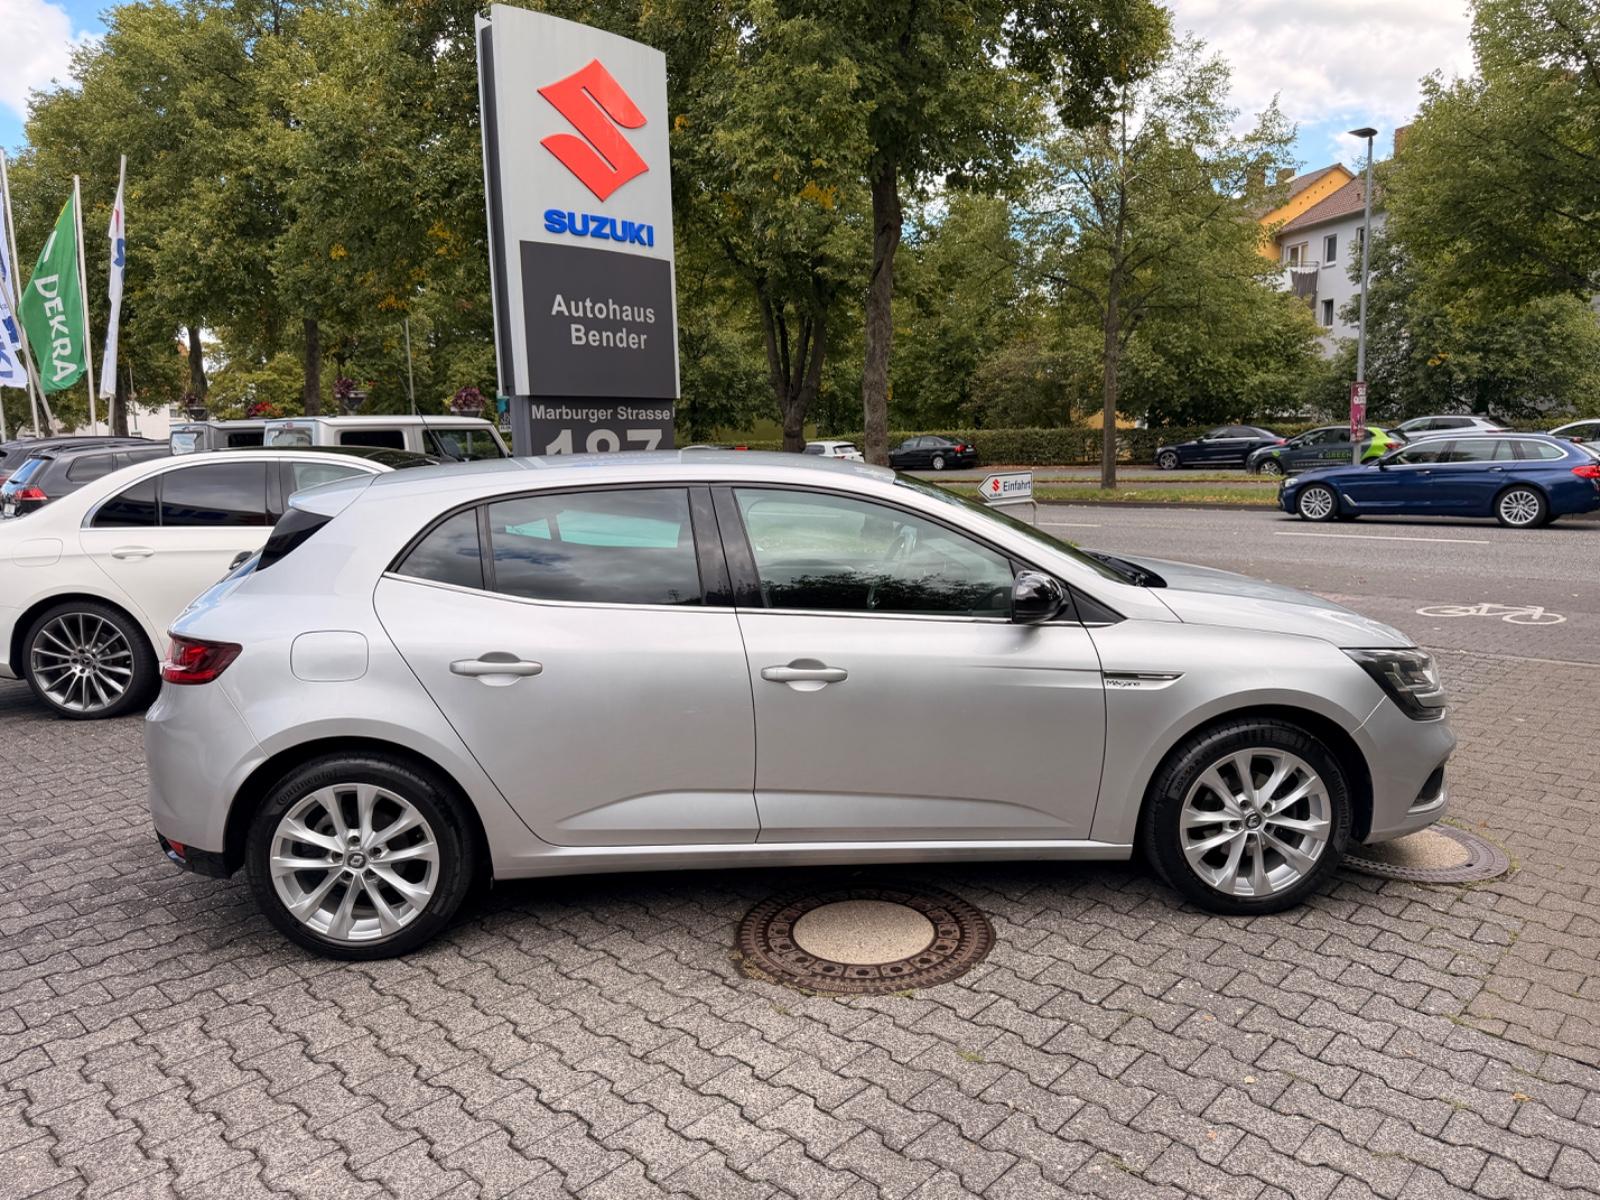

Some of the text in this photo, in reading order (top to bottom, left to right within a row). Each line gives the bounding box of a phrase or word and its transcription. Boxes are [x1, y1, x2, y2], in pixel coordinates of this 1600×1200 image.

[543, 209, 654, 247] SUZUKI
[551, 294, 656, 324] Autohaus
[34, 273, 78, 382] DEKRA
[570, 323, 647, 350] Bender
[531, 404, 671, 423] Marburger Strasse
[1003, 480, 1031, 492] Einfahrt
